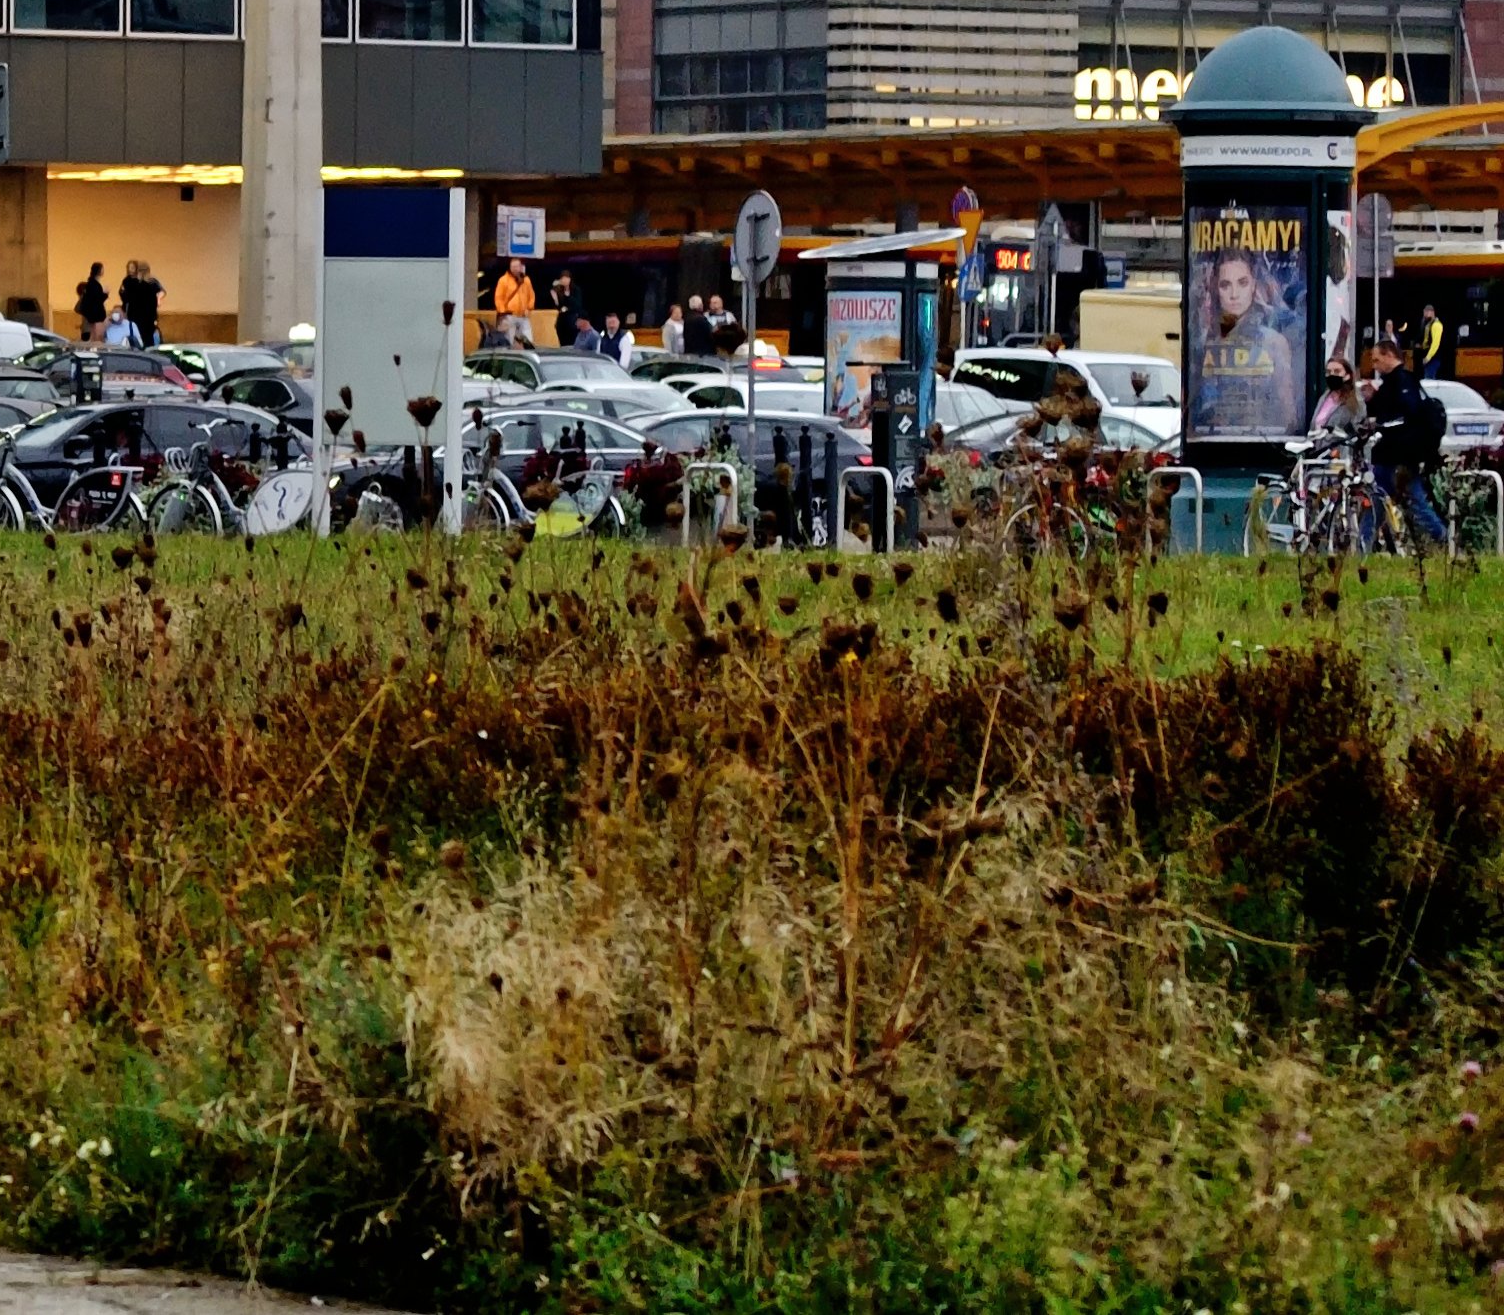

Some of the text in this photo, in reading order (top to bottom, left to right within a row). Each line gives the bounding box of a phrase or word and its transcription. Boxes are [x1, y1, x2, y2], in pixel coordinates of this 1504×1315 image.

[1220, 147, 1313, 157] WWW.WAREXPO.PL
[1190, 220, 1301, 253] WRACAMY!
[1203, 348, 1272, 367] AIDA
